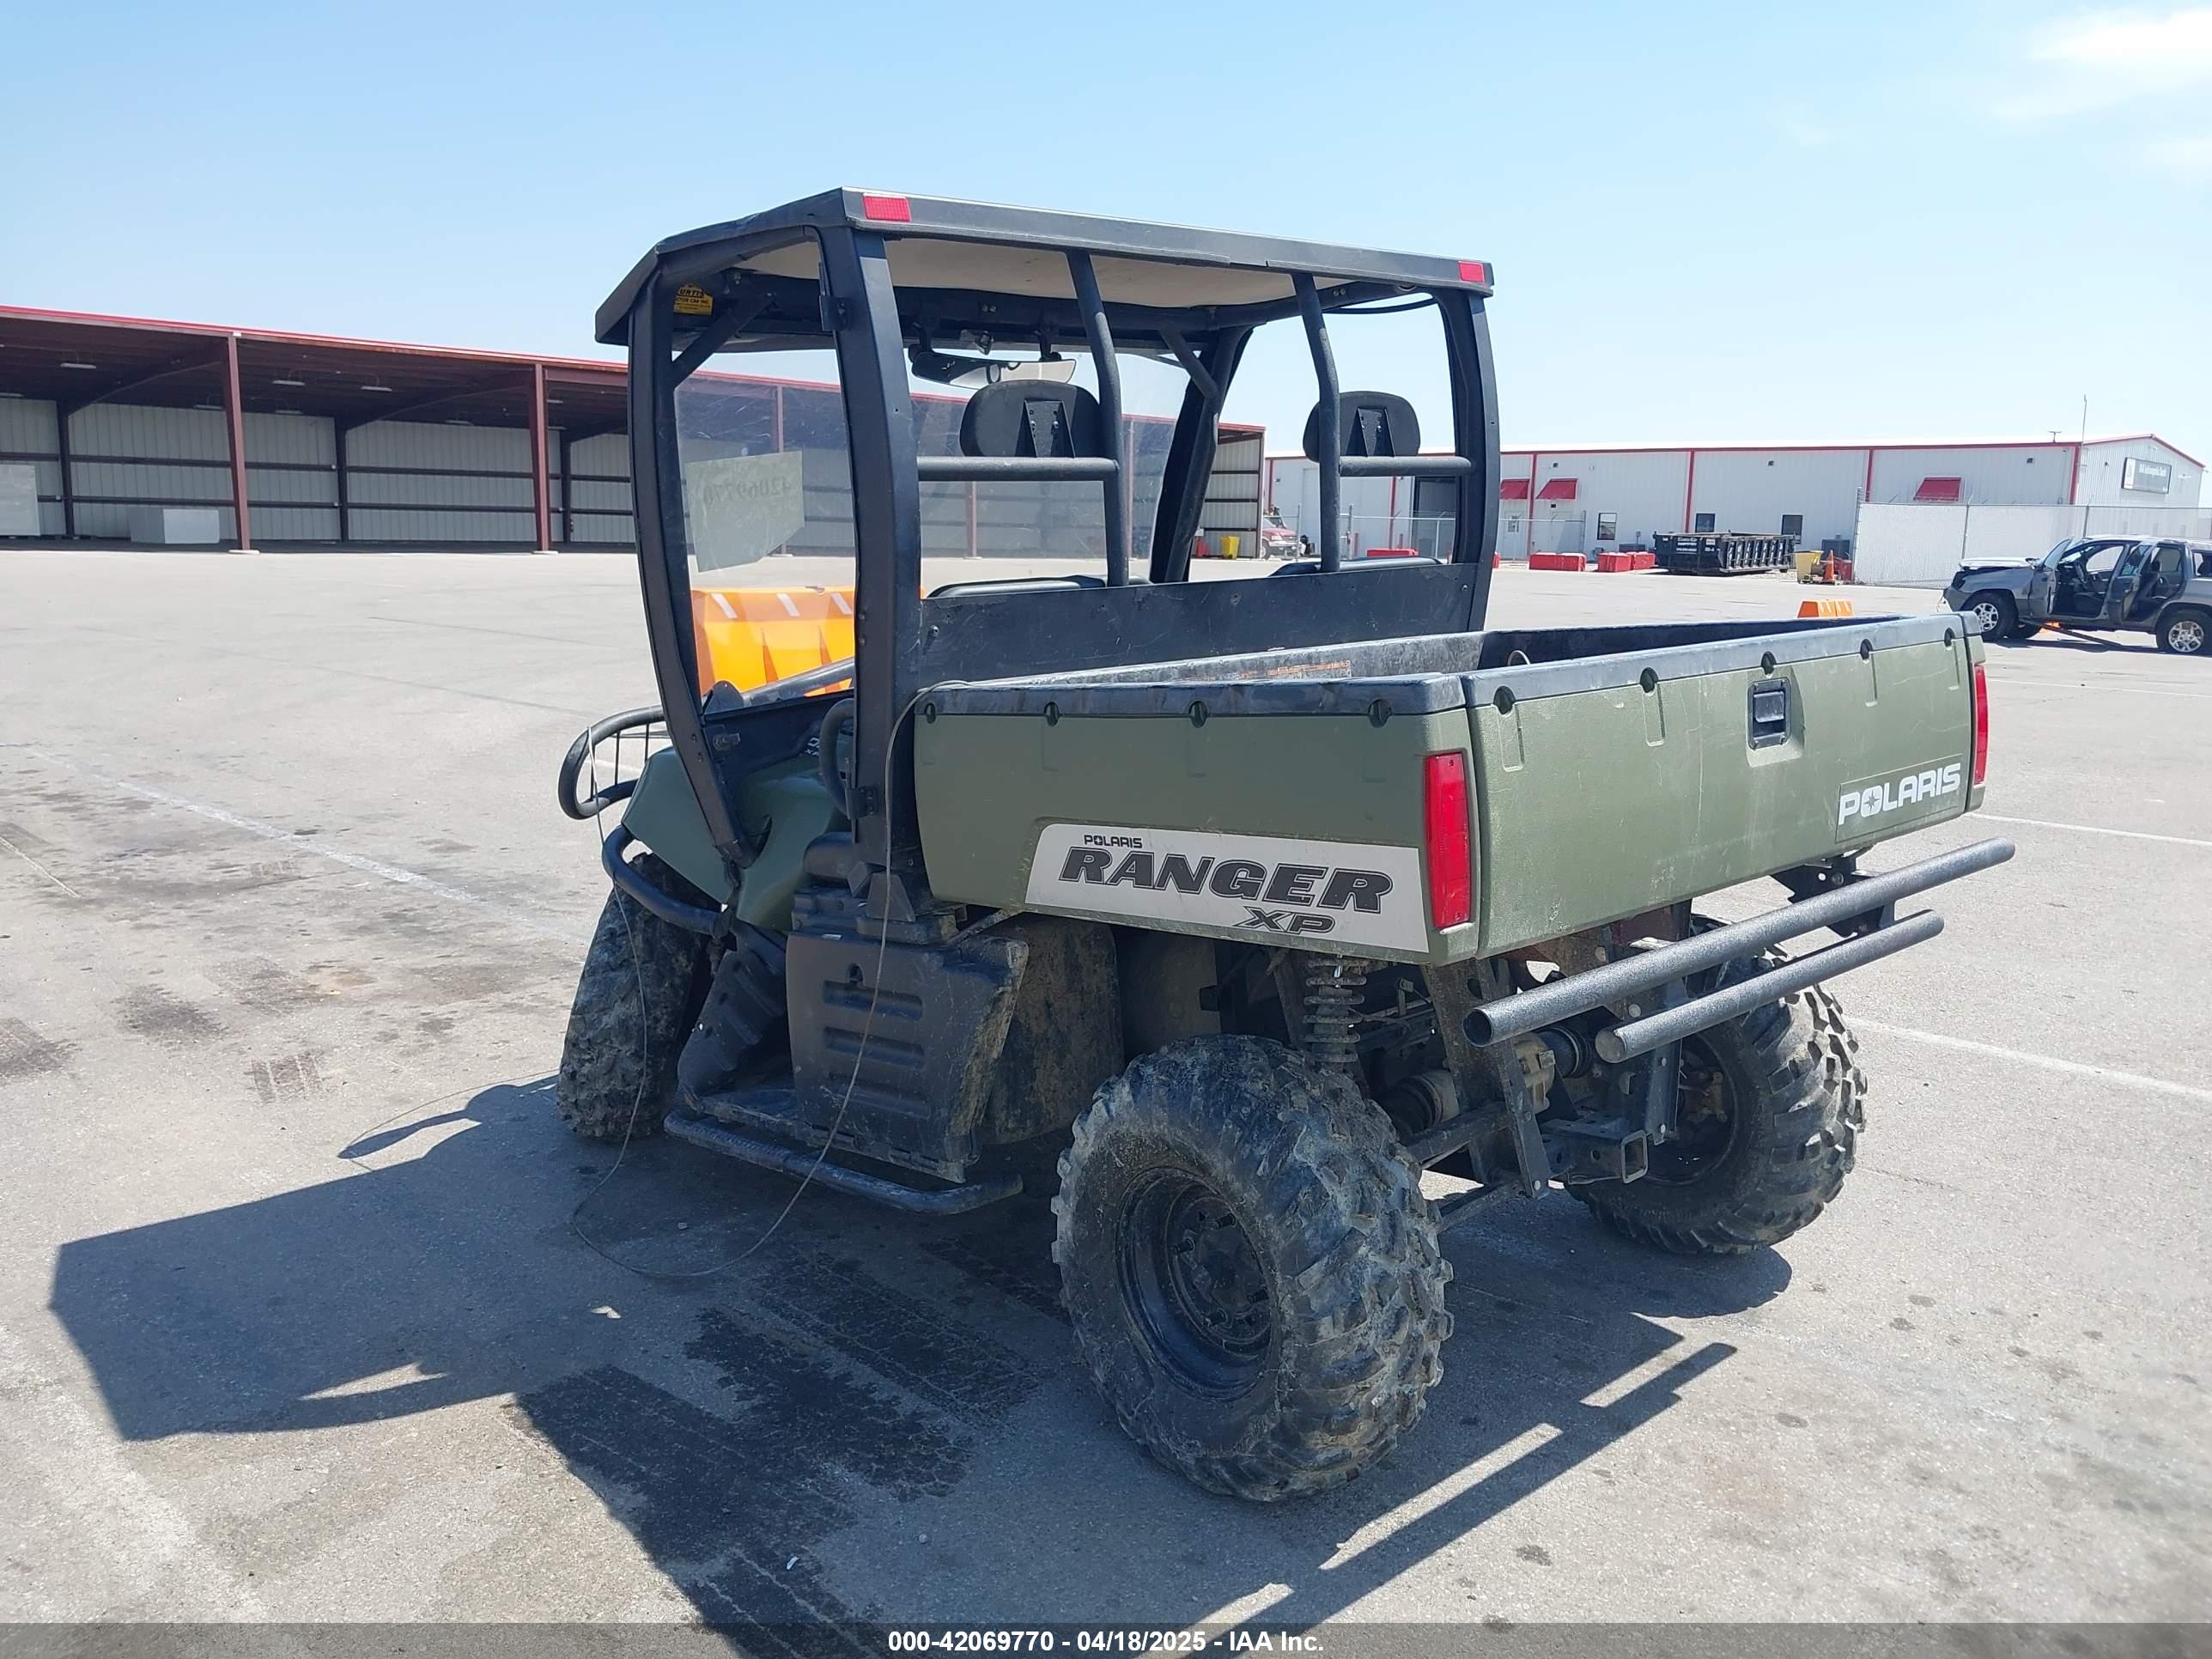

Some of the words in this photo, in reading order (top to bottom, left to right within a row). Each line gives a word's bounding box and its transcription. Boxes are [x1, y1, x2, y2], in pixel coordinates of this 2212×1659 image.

[679, 289, 704, 297] URTIS
[1838, 763, 1961, 825] POLARIS
[1084, 835, 1143, 849] POLARIS
[1058, 847, 1394, 915] RANGER
[1233, 906, 1335, 934] XP
